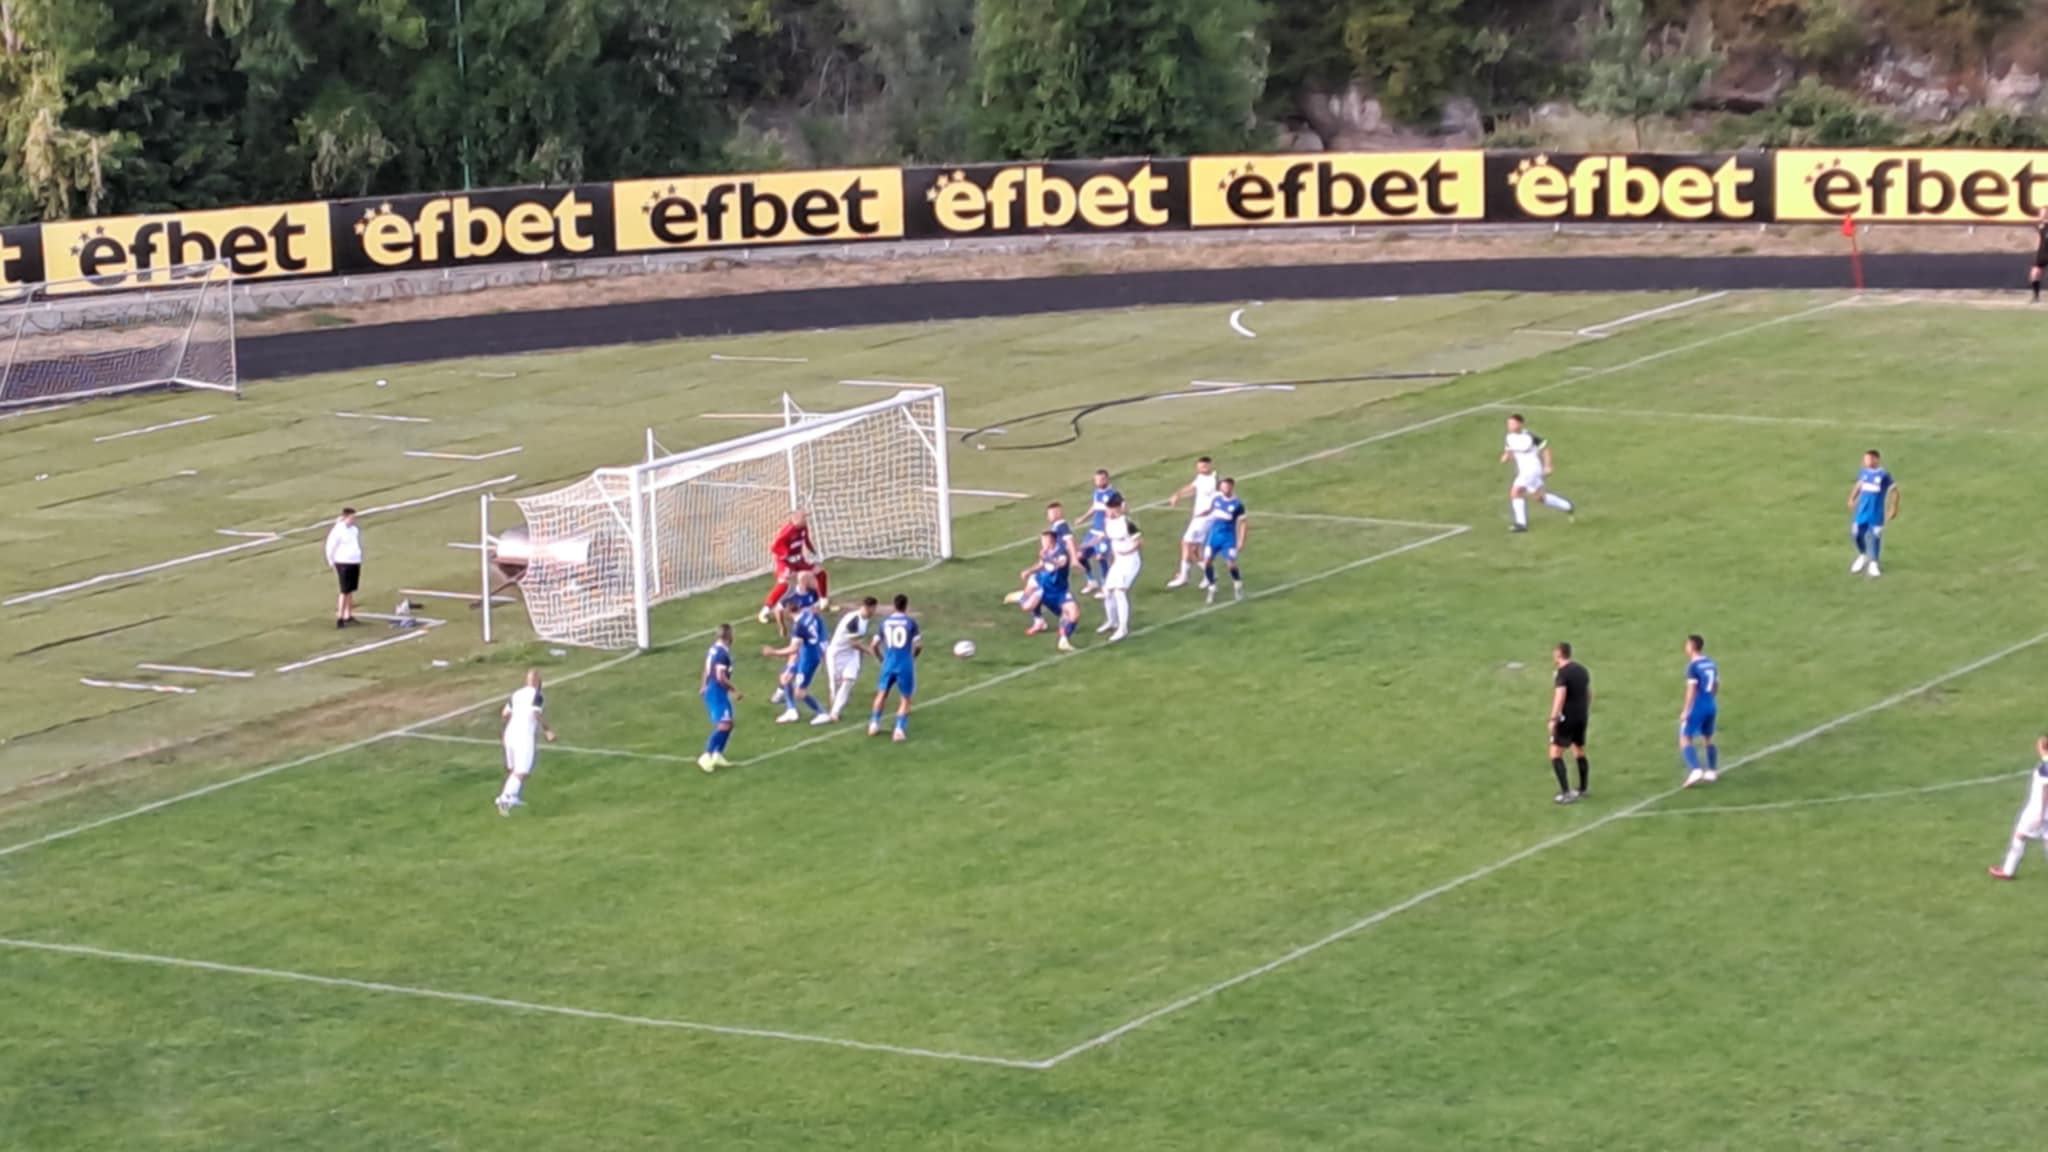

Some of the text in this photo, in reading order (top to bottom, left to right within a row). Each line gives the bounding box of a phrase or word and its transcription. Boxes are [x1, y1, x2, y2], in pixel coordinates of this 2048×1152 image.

[650, 177, 880, 243] efbet
[933, 164, 1168, 231] efbet
[1226, 158, 1458, 218] efbet
[1516, 157, 1754, 218] efbet
[1813, 157, 2048, 216] efbet
[80, 213, 308, 285] efbet
[362, 191, 594, 265] efbet
[884, 626, 907, 649] 10
